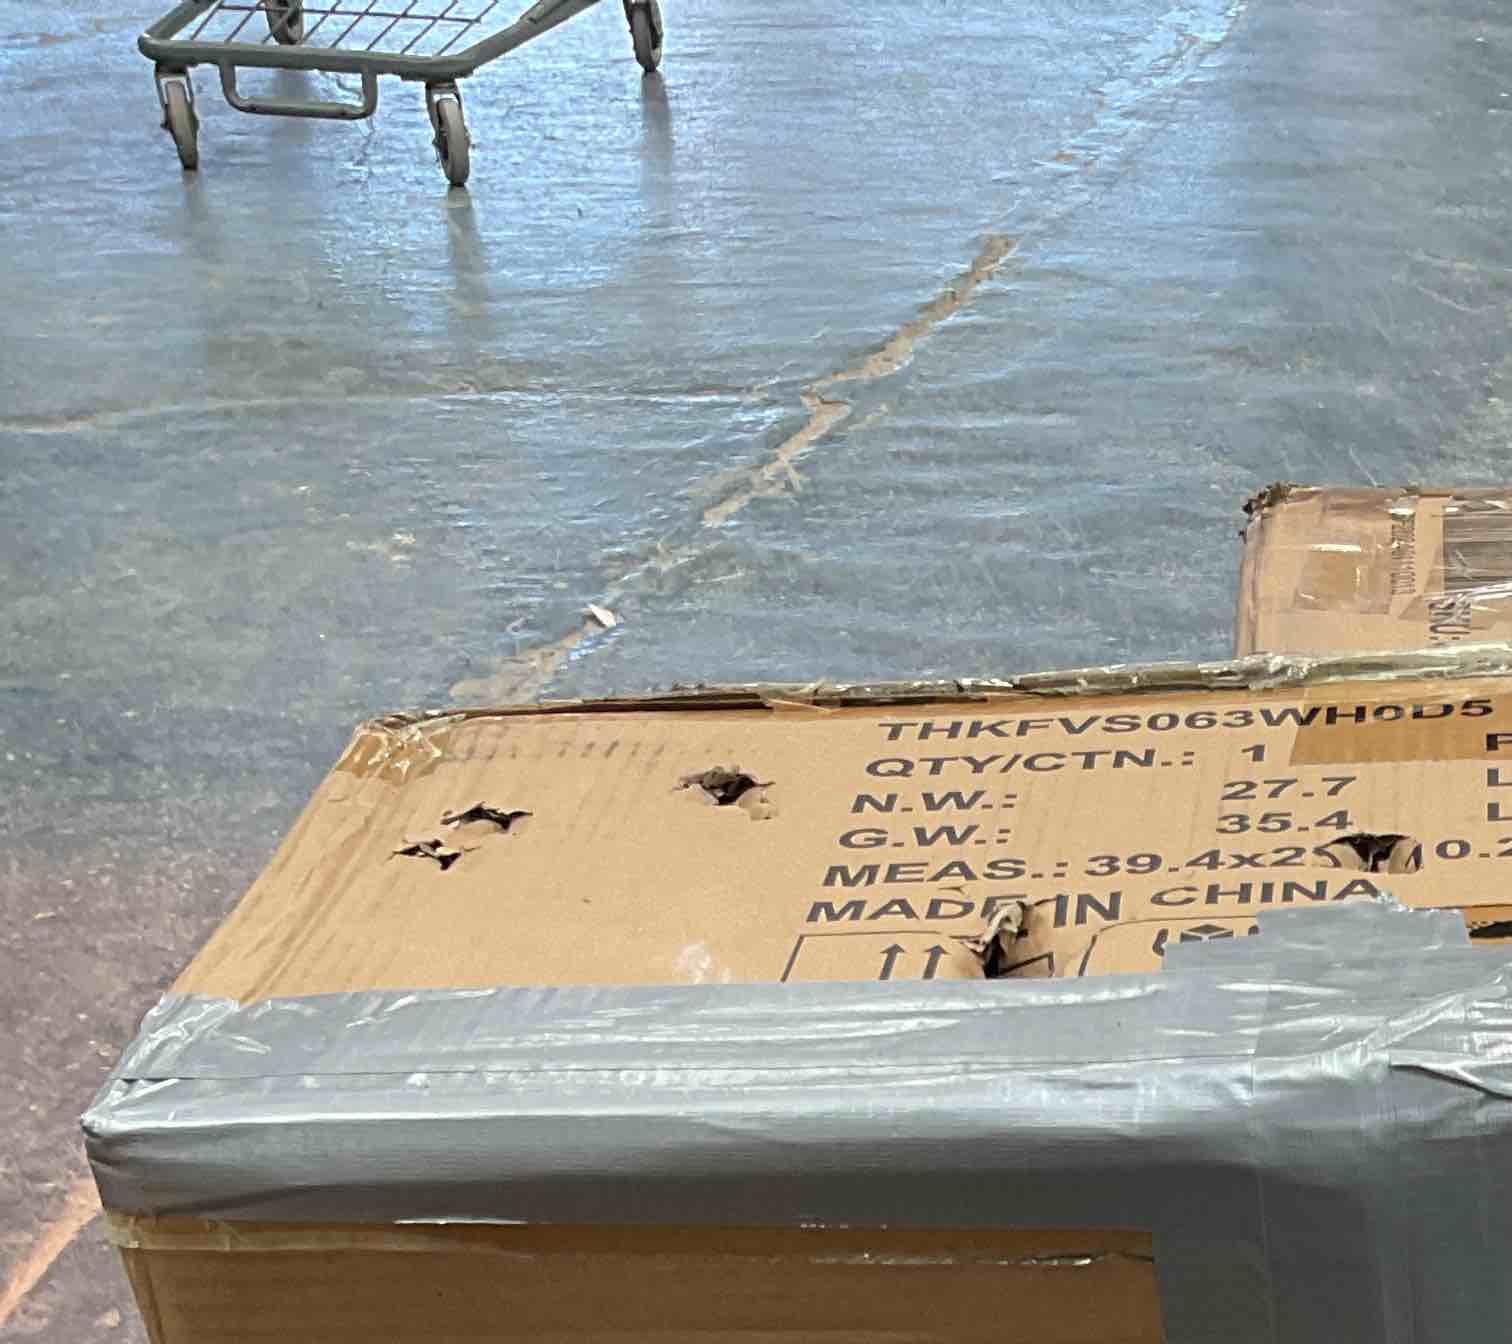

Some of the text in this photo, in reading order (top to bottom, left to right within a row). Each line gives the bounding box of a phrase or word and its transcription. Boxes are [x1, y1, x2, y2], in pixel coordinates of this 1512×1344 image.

[863, 748, 1197, 779] QTY/CTN.:
[1242, 744, 1268, 764] 1
[851, 790, 1018, 814] N.W.:
[1221, 777, 1358, 800] 27.7
[838, 824, 1010, 850] G.W.:
[1216, 811, 1354, 836] 35.4
[822, 858, 1070, 889] MEAS.:
[1053, 891, 1123, 928] IN
[1149, 878, 1380, 908] CHINA
